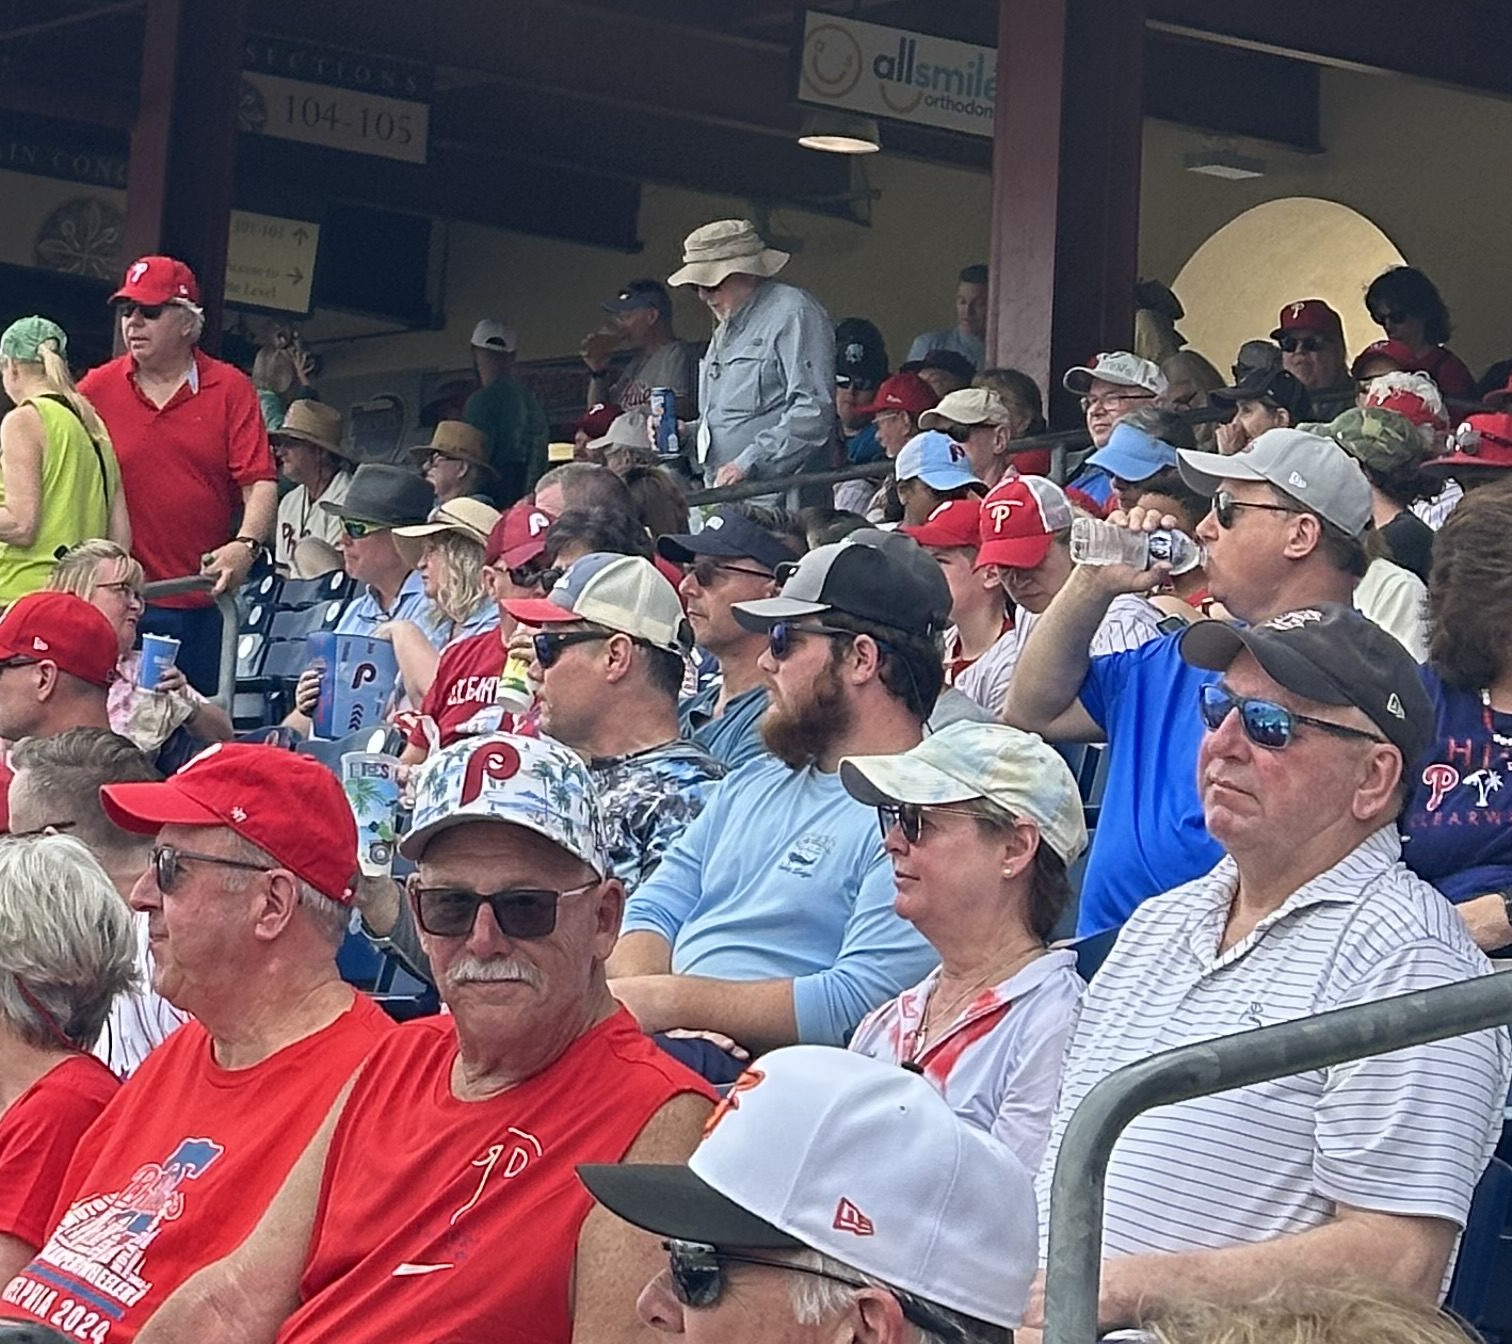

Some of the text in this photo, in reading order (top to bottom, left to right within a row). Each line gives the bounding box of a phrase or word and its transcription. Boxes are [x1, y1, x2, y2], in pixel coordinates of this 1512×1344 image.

[286, 95, 413, 144] 104-105
[991, 505, 1010, 533] P
[351, 662, 377, 690] P
[460, 741, 520, 807] P
[1422, 763, 1459, 811] P
[50, 1299, 110, 1344] 2024
